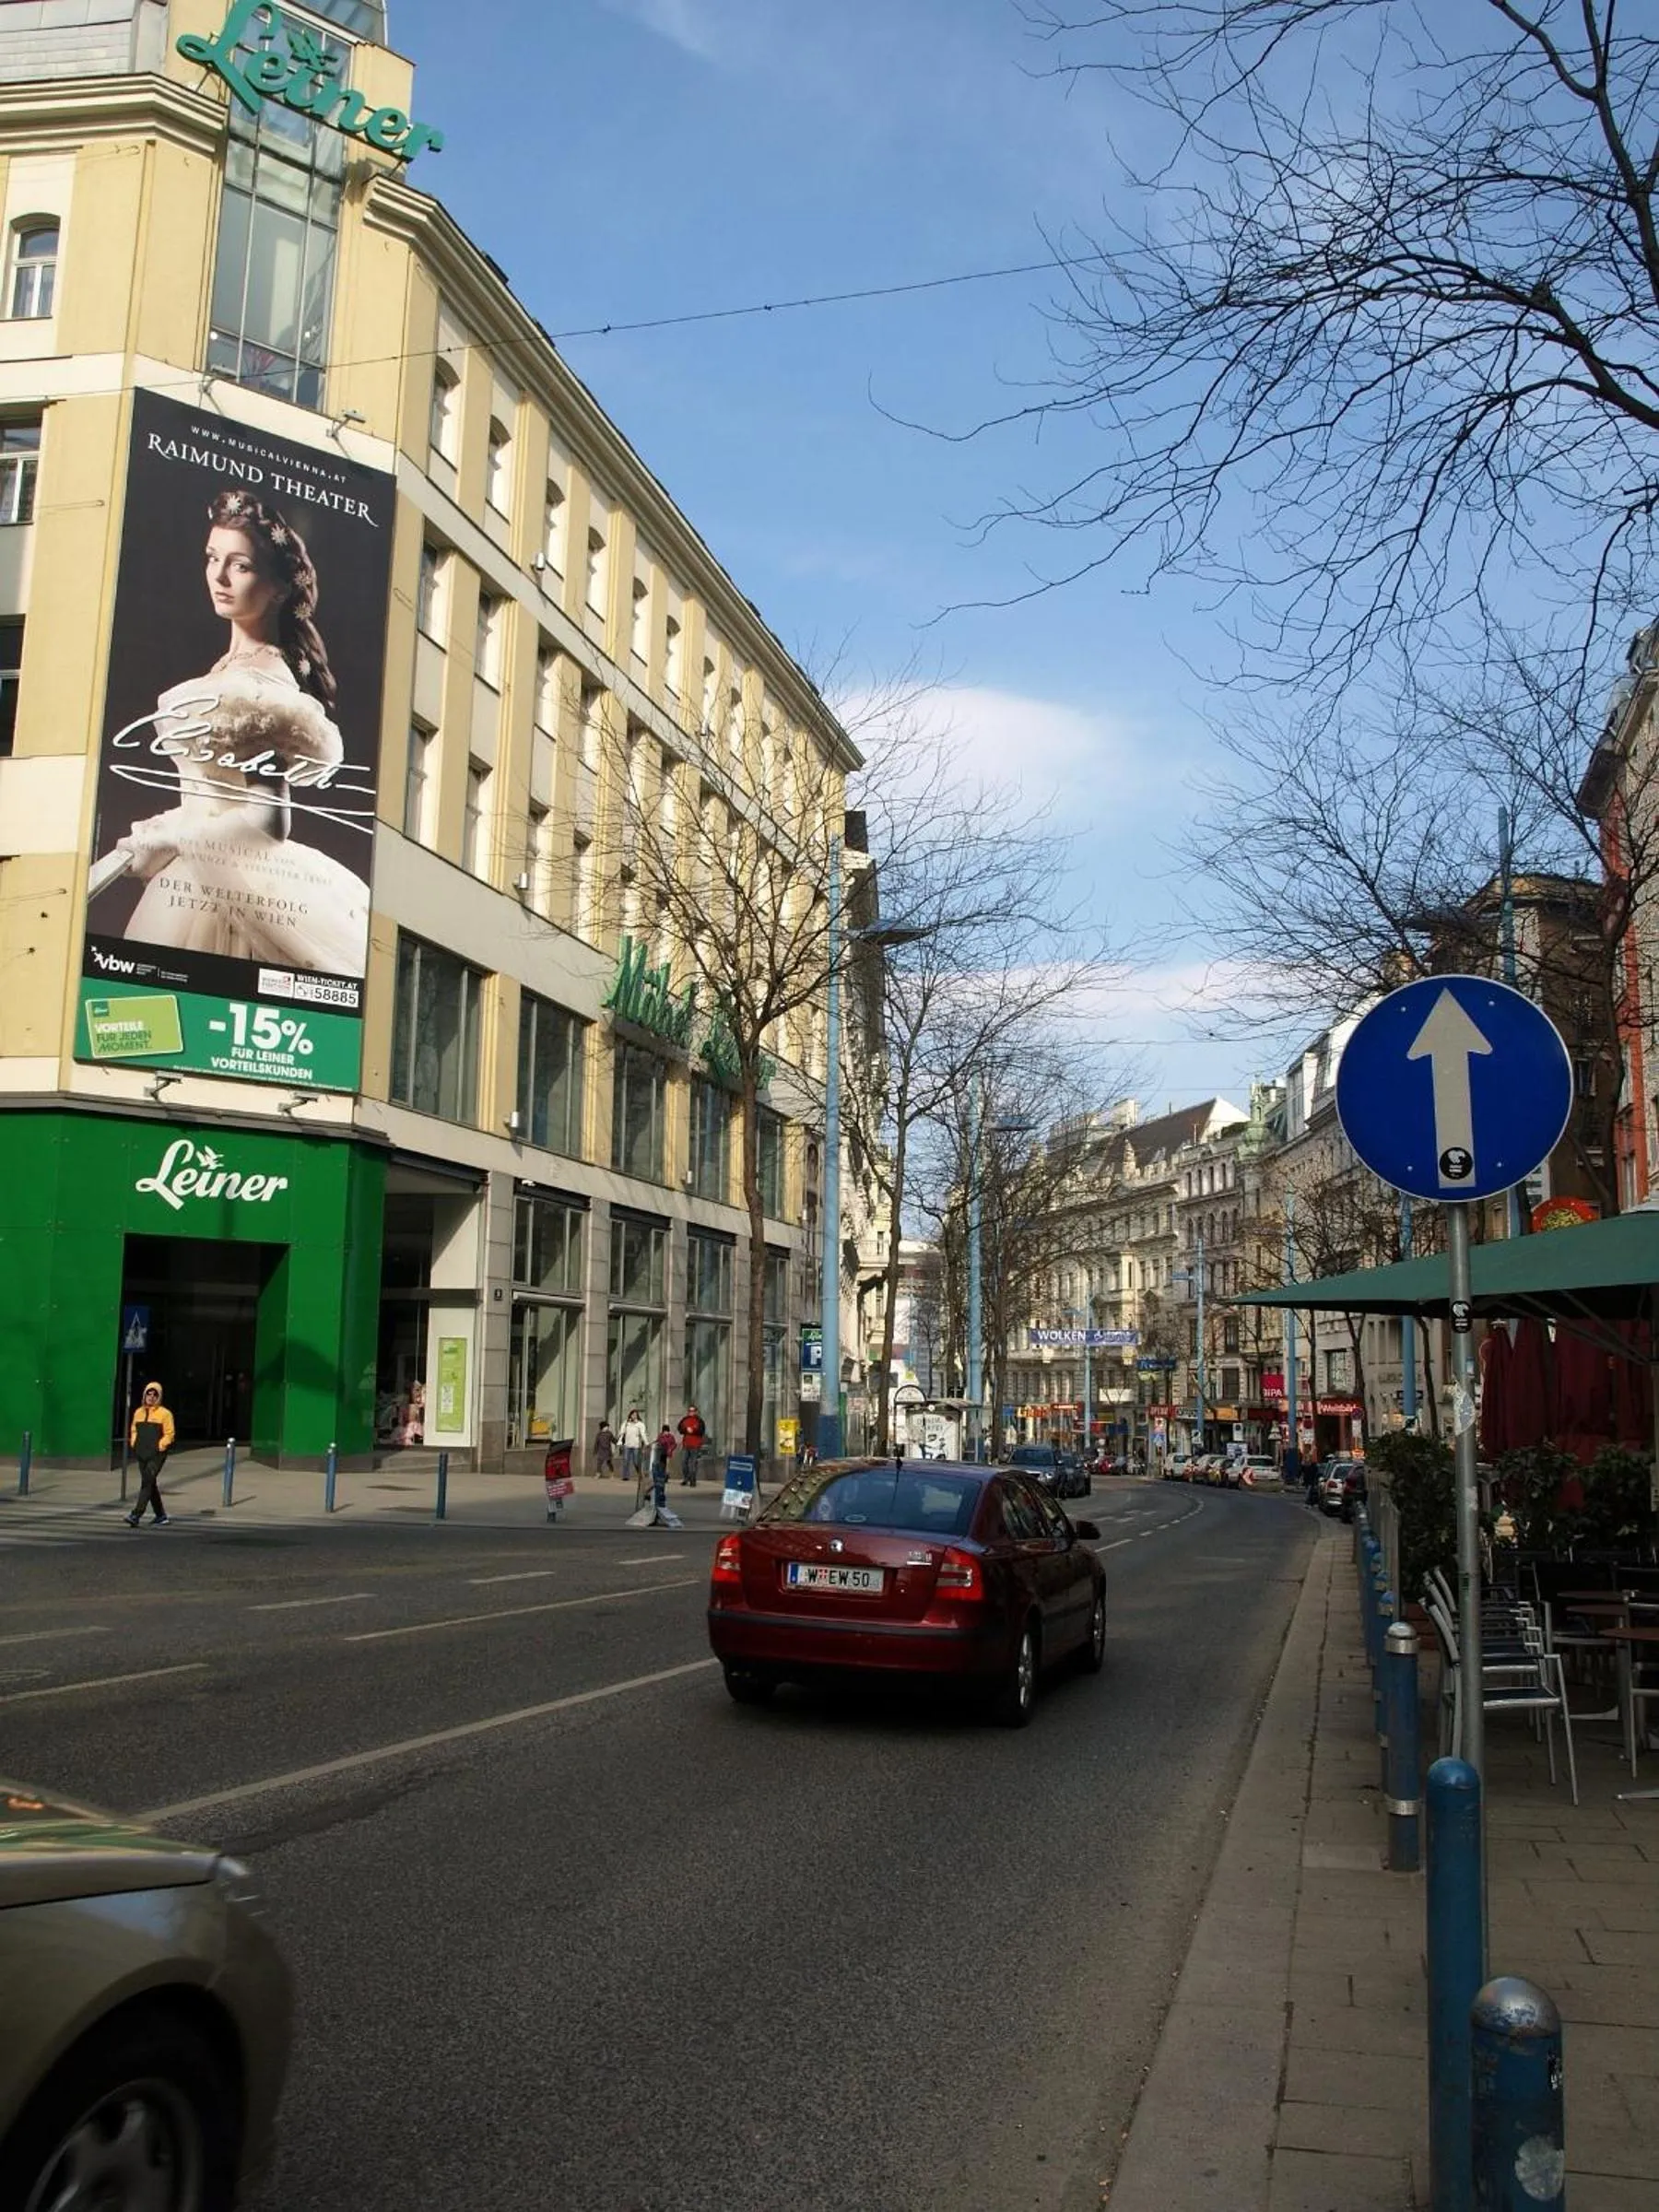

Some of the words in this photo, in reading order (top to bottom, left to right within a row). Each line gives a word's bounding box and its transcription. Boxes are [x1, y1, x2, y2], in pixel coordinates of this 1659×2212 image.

[175, 0, 444, 163] Leiner
[147, 432, 264, 484] RAIMUND
[271, 472, 379, 528] THEATER
[159, 877, 192, 893] DER
[201, 884, 309, 915] WELTERFOLG
[168, 895, 221, 912] JETZT
[229, 905, 245, 917] IN
[253, 910, 297, 928] WIEN
[98, 954, 135, 974] vbw
[314, 988, 358, 1005] 58885
[209, 1002, 313, 1054] -15%
[211, 1057, 312, 1080] VORTEILSKUNDEN
[256, 1051, 295, 1065] LEINER
[135, 1139, 288, 1210] Leiner
[1037, 1330, 1086, 1341] WOLKEN
